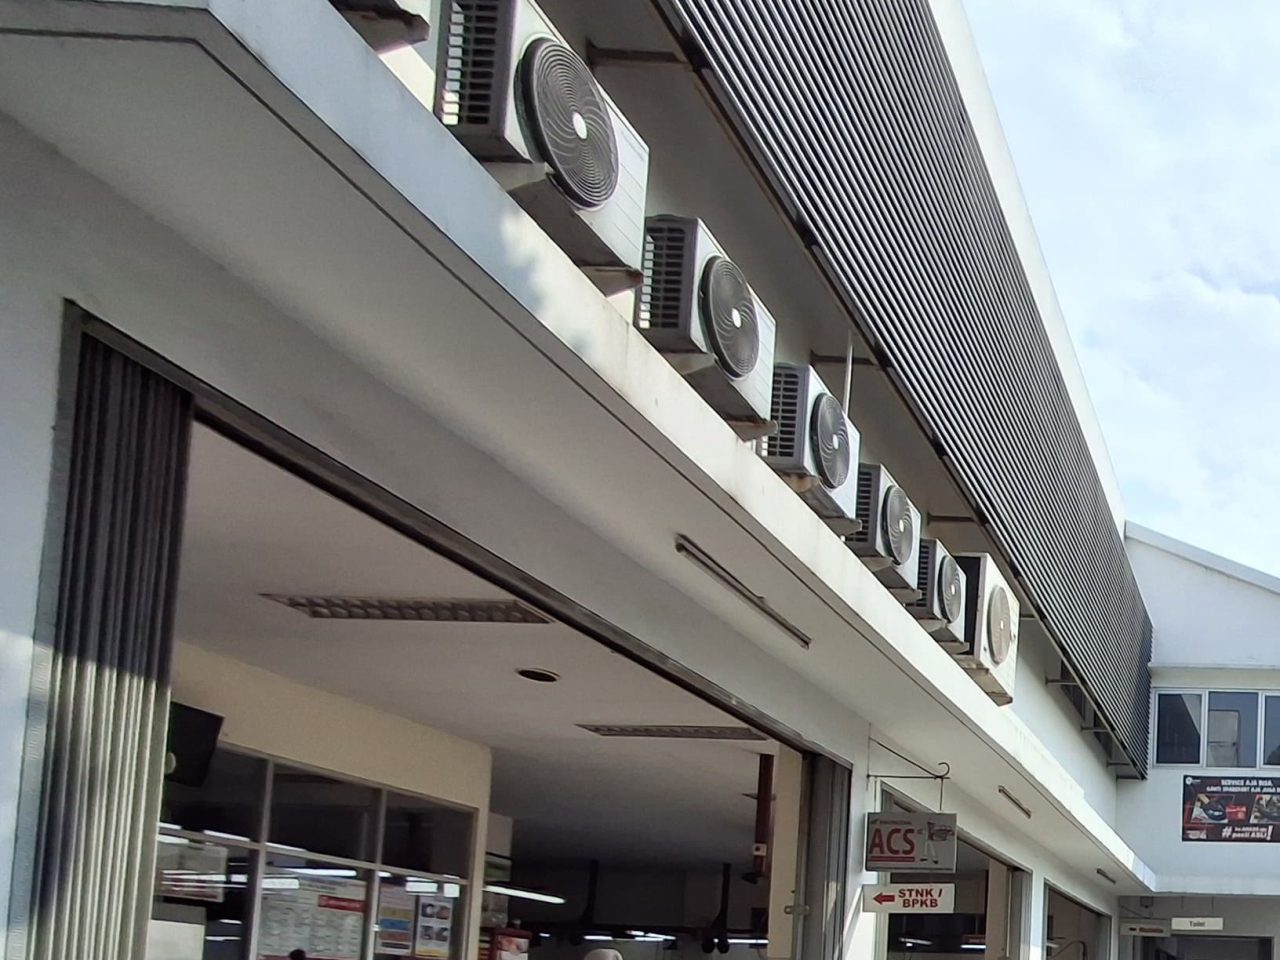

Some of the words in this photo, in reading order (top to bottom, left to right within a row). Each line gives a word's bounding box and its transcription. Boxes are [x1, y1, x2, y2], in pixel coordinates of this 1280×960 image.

[869, 828, 915, 855] ACS
[898, 888, 934, 898] STNK
[902, 899, 939, 908] BPKB
